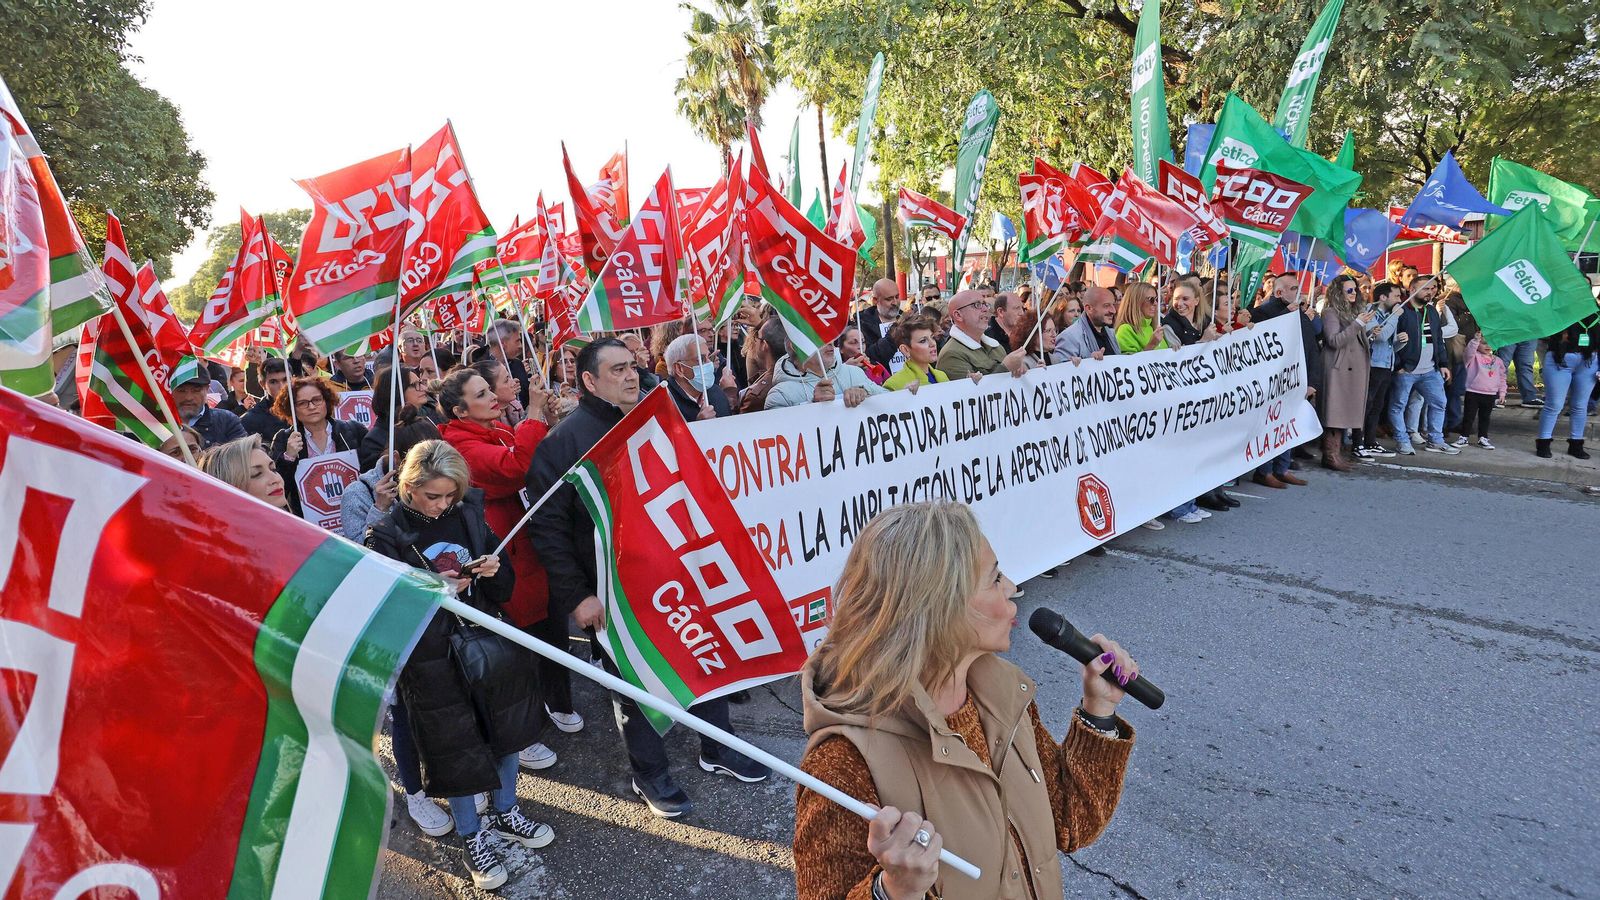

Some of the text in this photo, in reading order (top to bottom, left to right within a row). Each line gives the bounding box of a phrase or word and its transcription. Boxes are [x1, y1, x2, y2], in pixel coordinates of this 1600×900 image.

[1242, 205, 1286, 226] Cádiz
[612, 251, 645, 319] Cádiz
[771, 255, 838, 327] Cádiz
[1509, 260, 1542, 302] Fetico
[356, 412, 369, 422] NO
[816, 425, 845, 478] LA
[855, 405, 948, 467] APERTURA
[953, 388, 1030, 441] ILIMITADA
[1033, 382, 1052, 421] DE
[1050, 380, 1070, 417] LAS
[1071, 366, 1135, 410] GRANDES
[1137, 354, 1216, 395] SUPERFICIES
[1213, 332, 1284, 375] COMERCIALES
[1265, 400, 1282, 425] NO
[1245, 418, 1299, 462] A LA ZGAT
[325, 482, 343, 498] NO
[798, 507, 830, 562] LA
[961, 457, 983, 504] DE
[986, 454, 1005, 496] LA
[1011, 435, 1072, 487] APERTURA
[1074, 426, 1089, 465] DE
[1087, 411, 1158, 458] DOMINGOS
[1162, 406, 1173, 435] Y
[1174, 391, 1236, 434] FESTIVOS
[1236, 385, 1252, 415] EN
[1252, 380, 1265, 409] EL
[626, 415, 783, 661] CCOO
[652, 580, 726, 675] Cádiz
